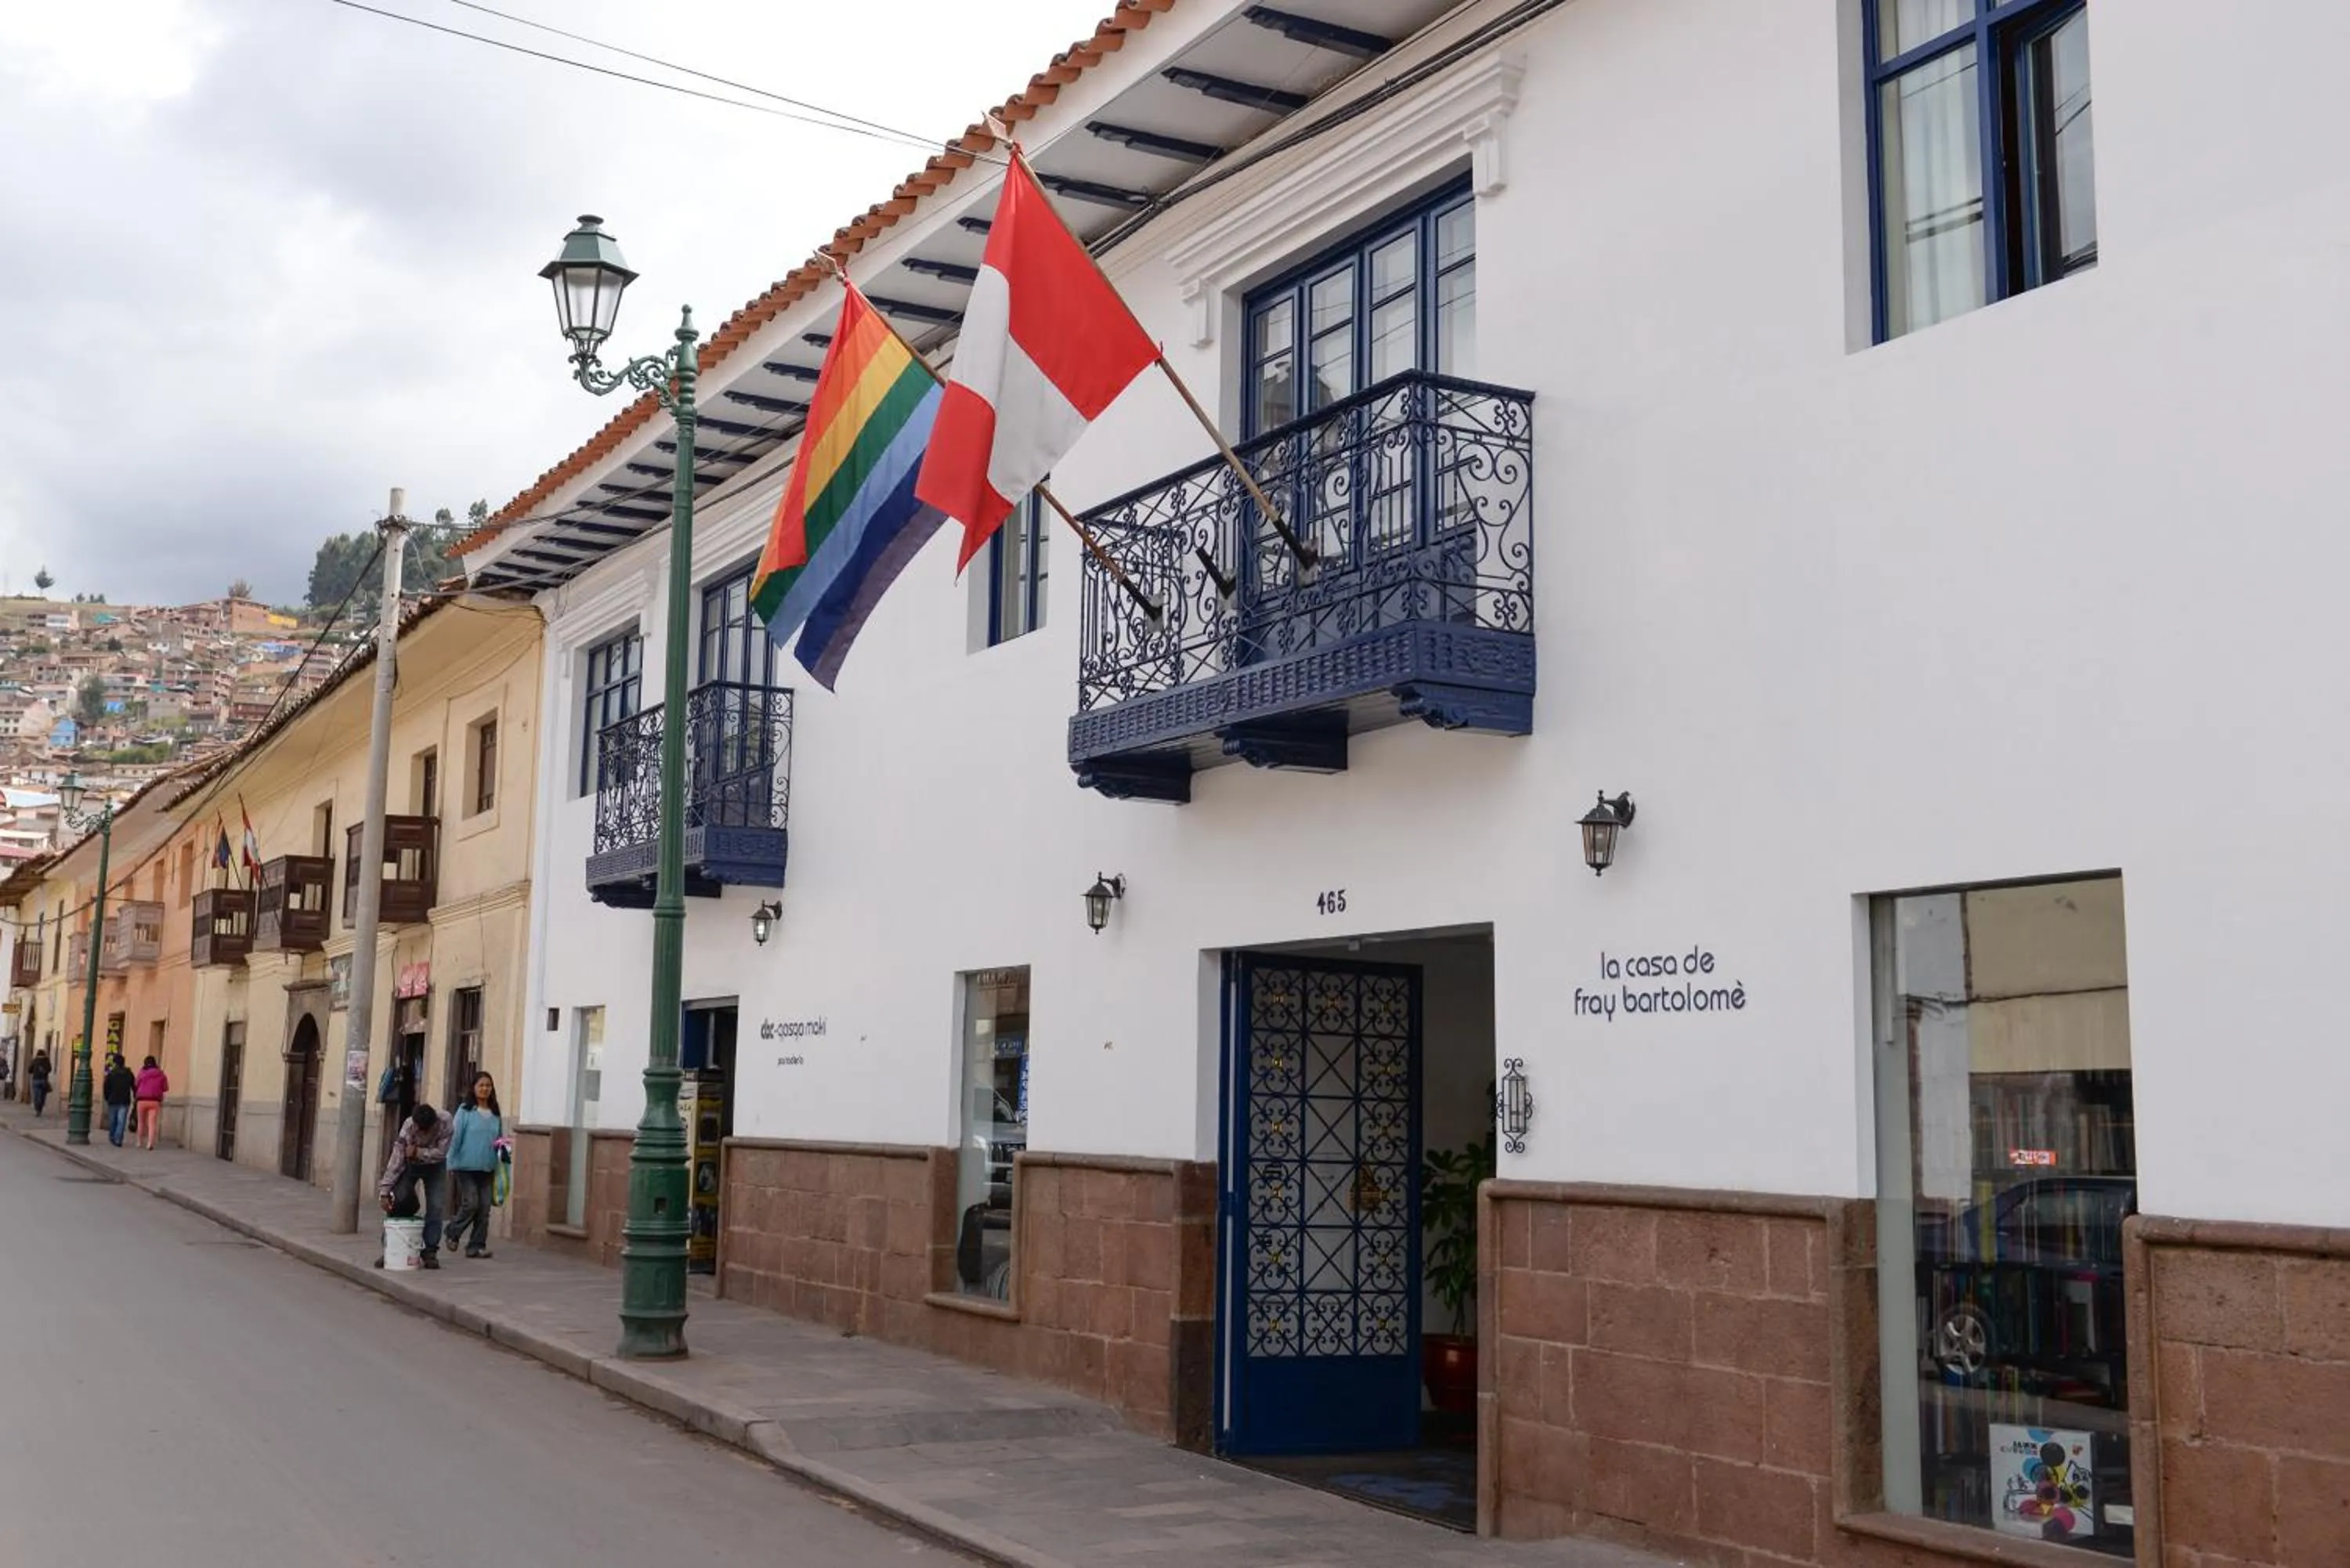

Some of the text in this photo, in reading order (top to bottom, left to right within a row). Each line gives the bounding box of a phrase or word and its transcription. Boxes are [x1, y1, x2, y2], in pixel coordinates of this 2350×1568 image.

[1316, 889, 1347, 916] 465
[1601, 945, 1715, 979] la casa de
[1574, 988, 1616, 1022] fray
